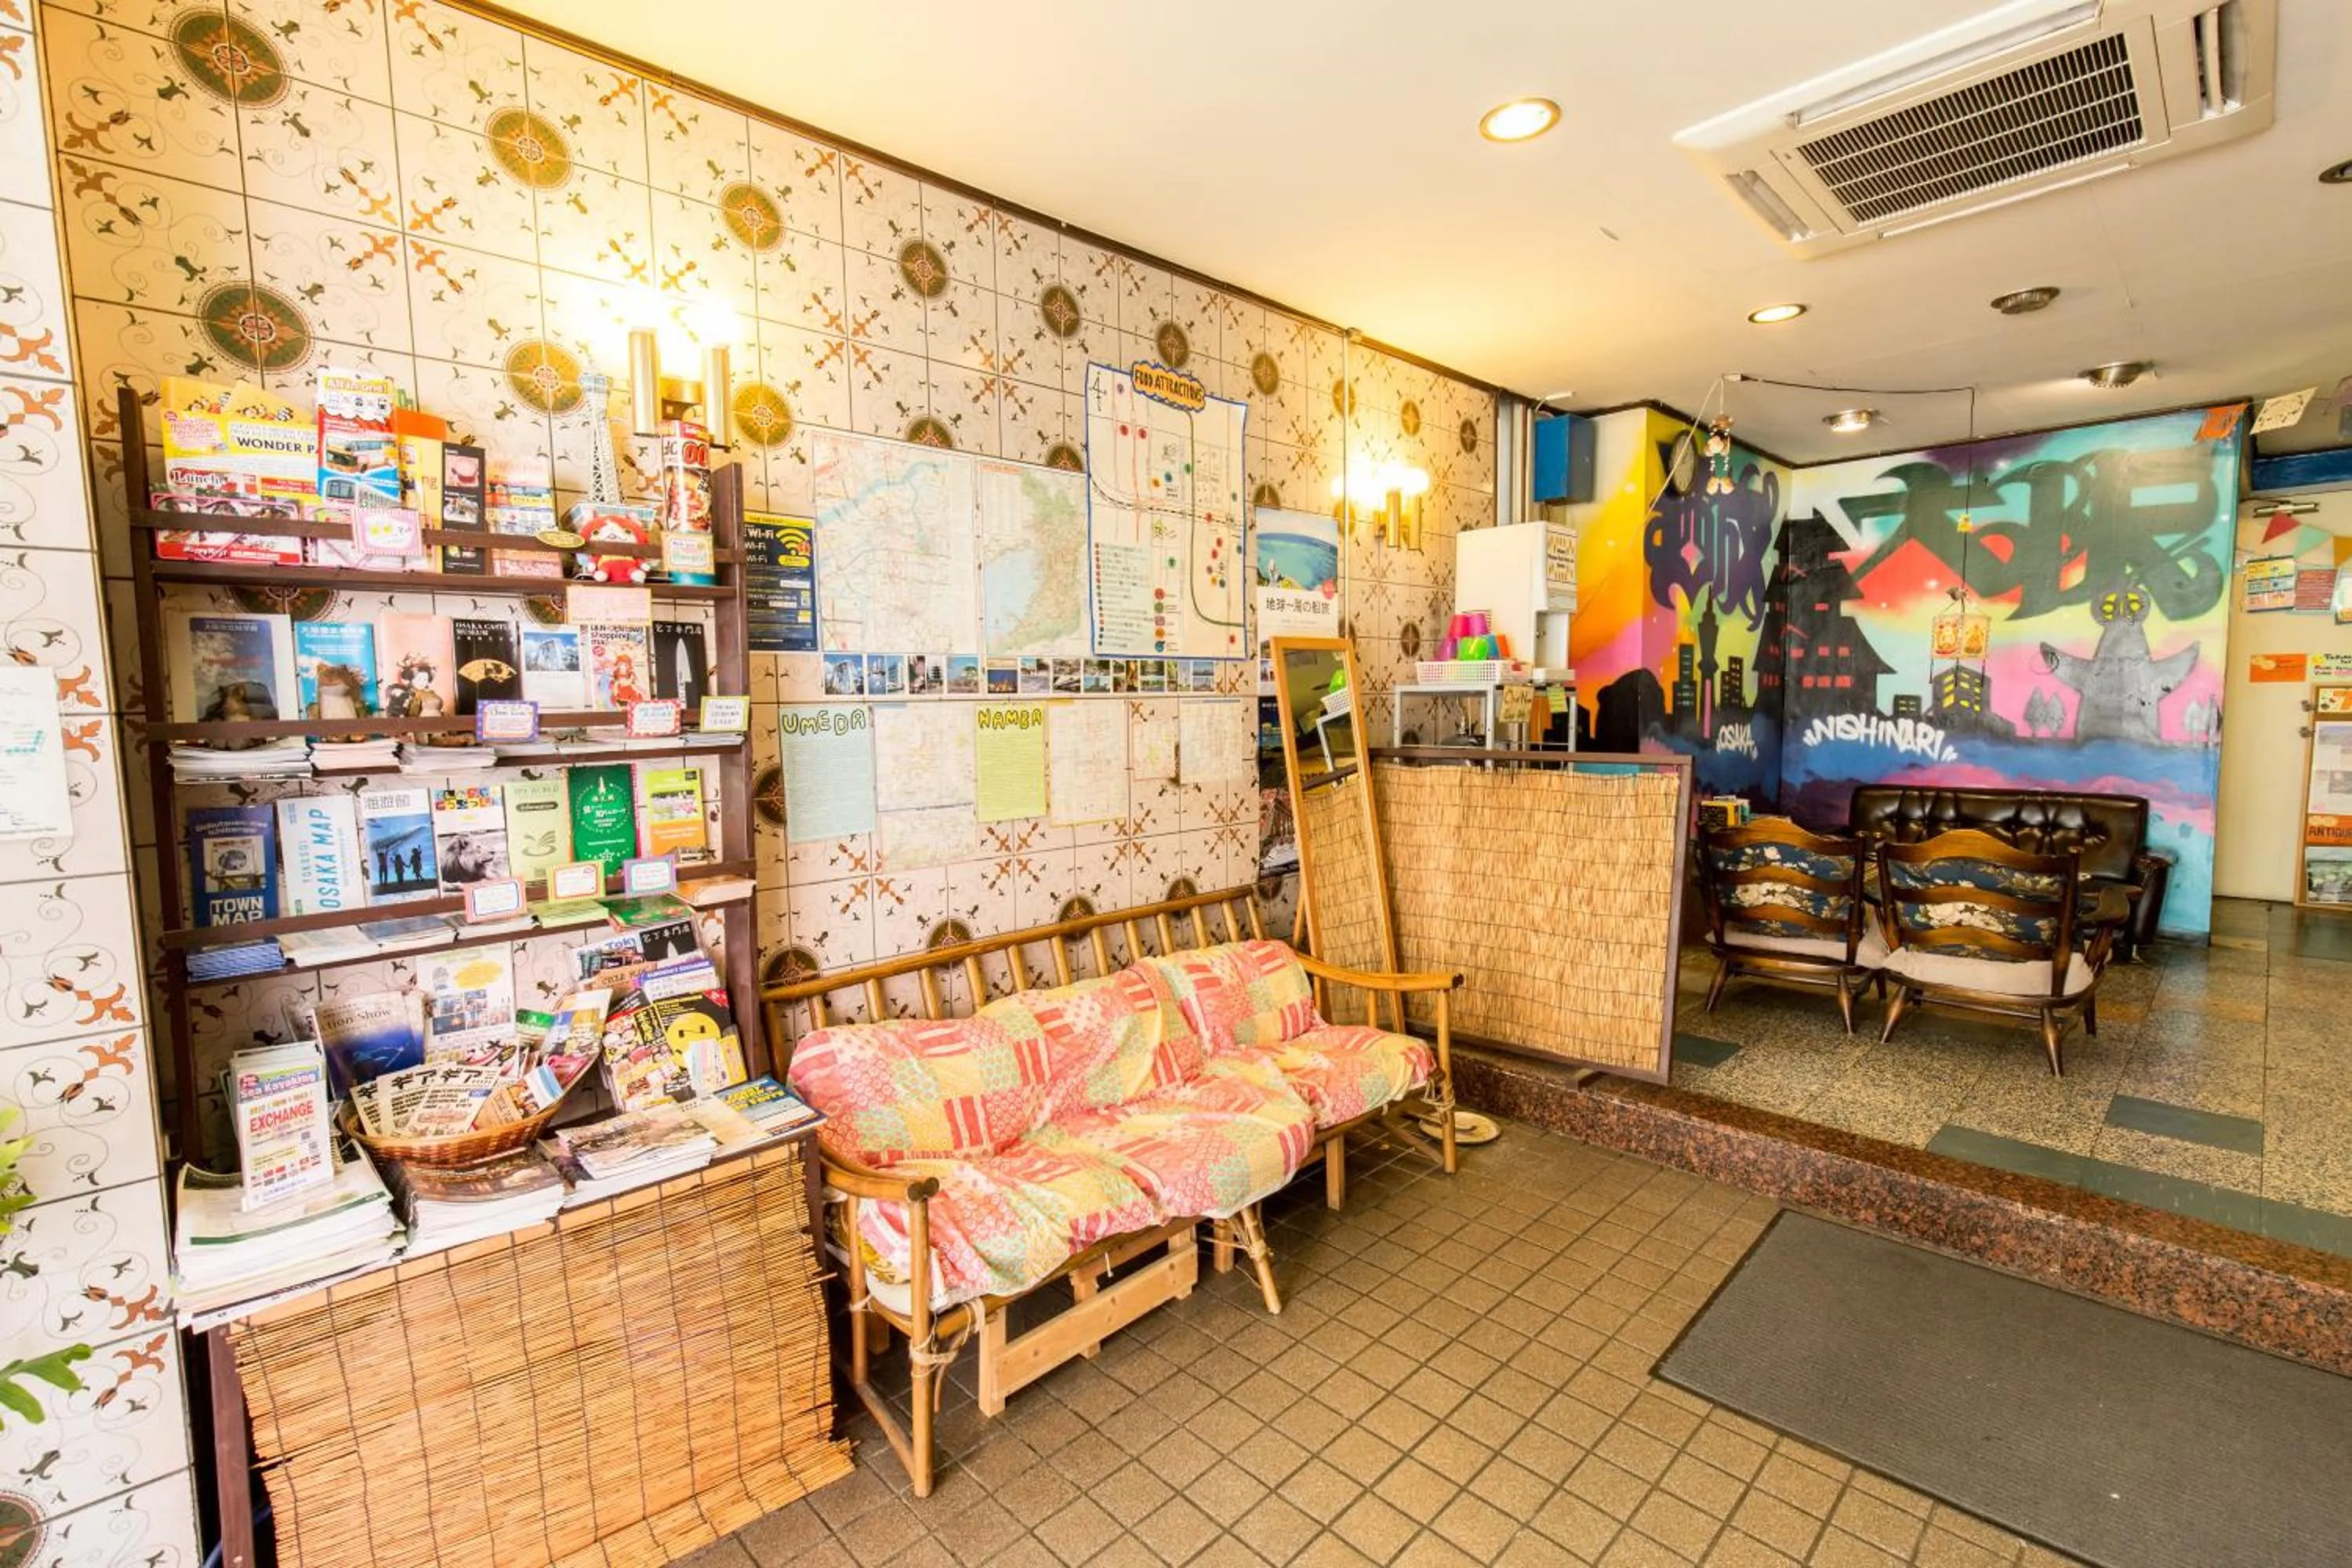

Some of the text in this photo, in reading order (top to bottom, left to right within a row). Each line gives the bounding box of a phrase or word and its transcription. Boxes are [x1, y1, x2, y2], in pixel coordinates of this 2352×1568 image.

[238, 437, 303, 452] WONDER
[783, 709, 866, 735] UMEDA
[978, 708, 1042, 730] NAMBA
[1813, 713, 1945, 760] NISHINARI
[309, 808, 335, 845] MAP
[314, 854, 342, 908] OSAKA
[212, 896, 263, 913] TOWN
[212, 911, 263, 927] MAP
[250, 1101, 314, 1133] EXCHANGE
